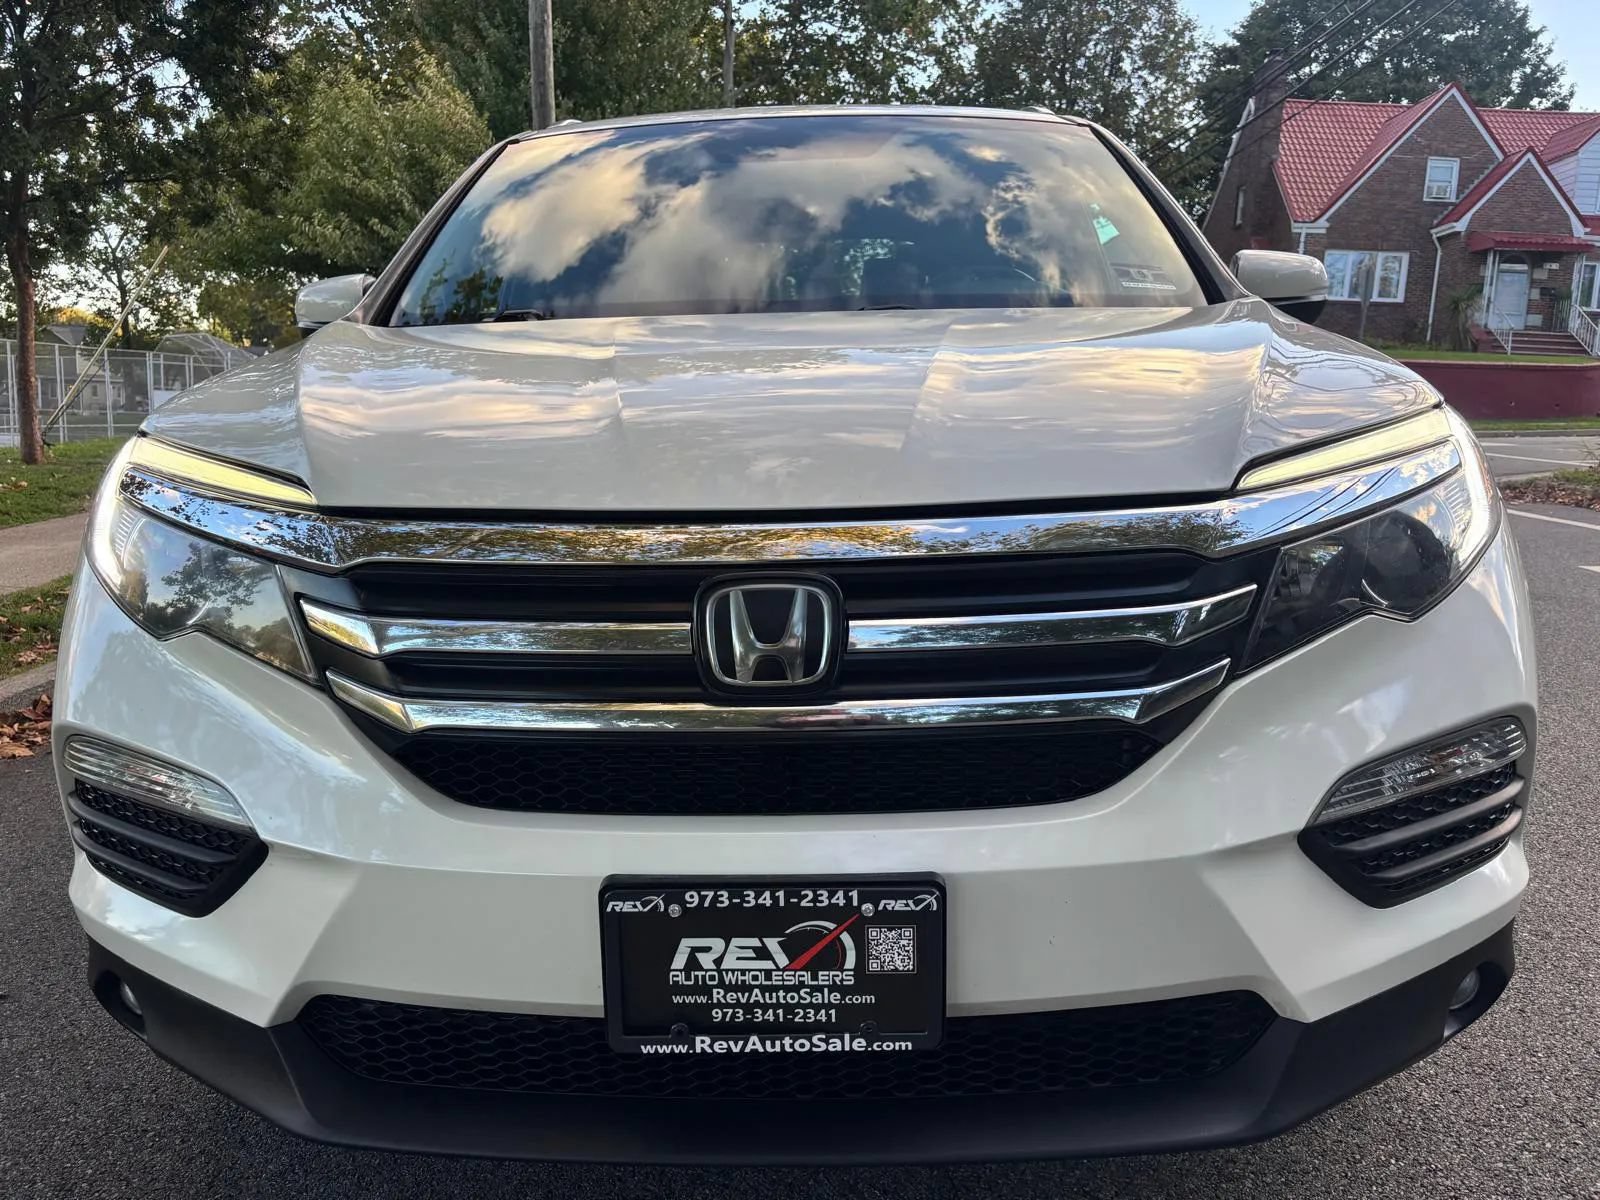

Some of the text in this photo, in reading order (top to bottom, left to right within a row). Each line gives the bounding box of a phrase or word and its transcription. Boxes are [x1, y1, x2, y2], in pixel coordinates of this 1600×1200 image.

[684, 889, 860, 908] 973-341-2341
[670, 928, 838, 970] REV
[669, 971, 855, 985] AUTO WHOLESALERS
[672, 988, 876, 1004] www.RevAutoSale.com
[711, 1008, 837, 1022] 973-341-2341
[640, 1034, 913, 1054] www.RevAutoSale.com
